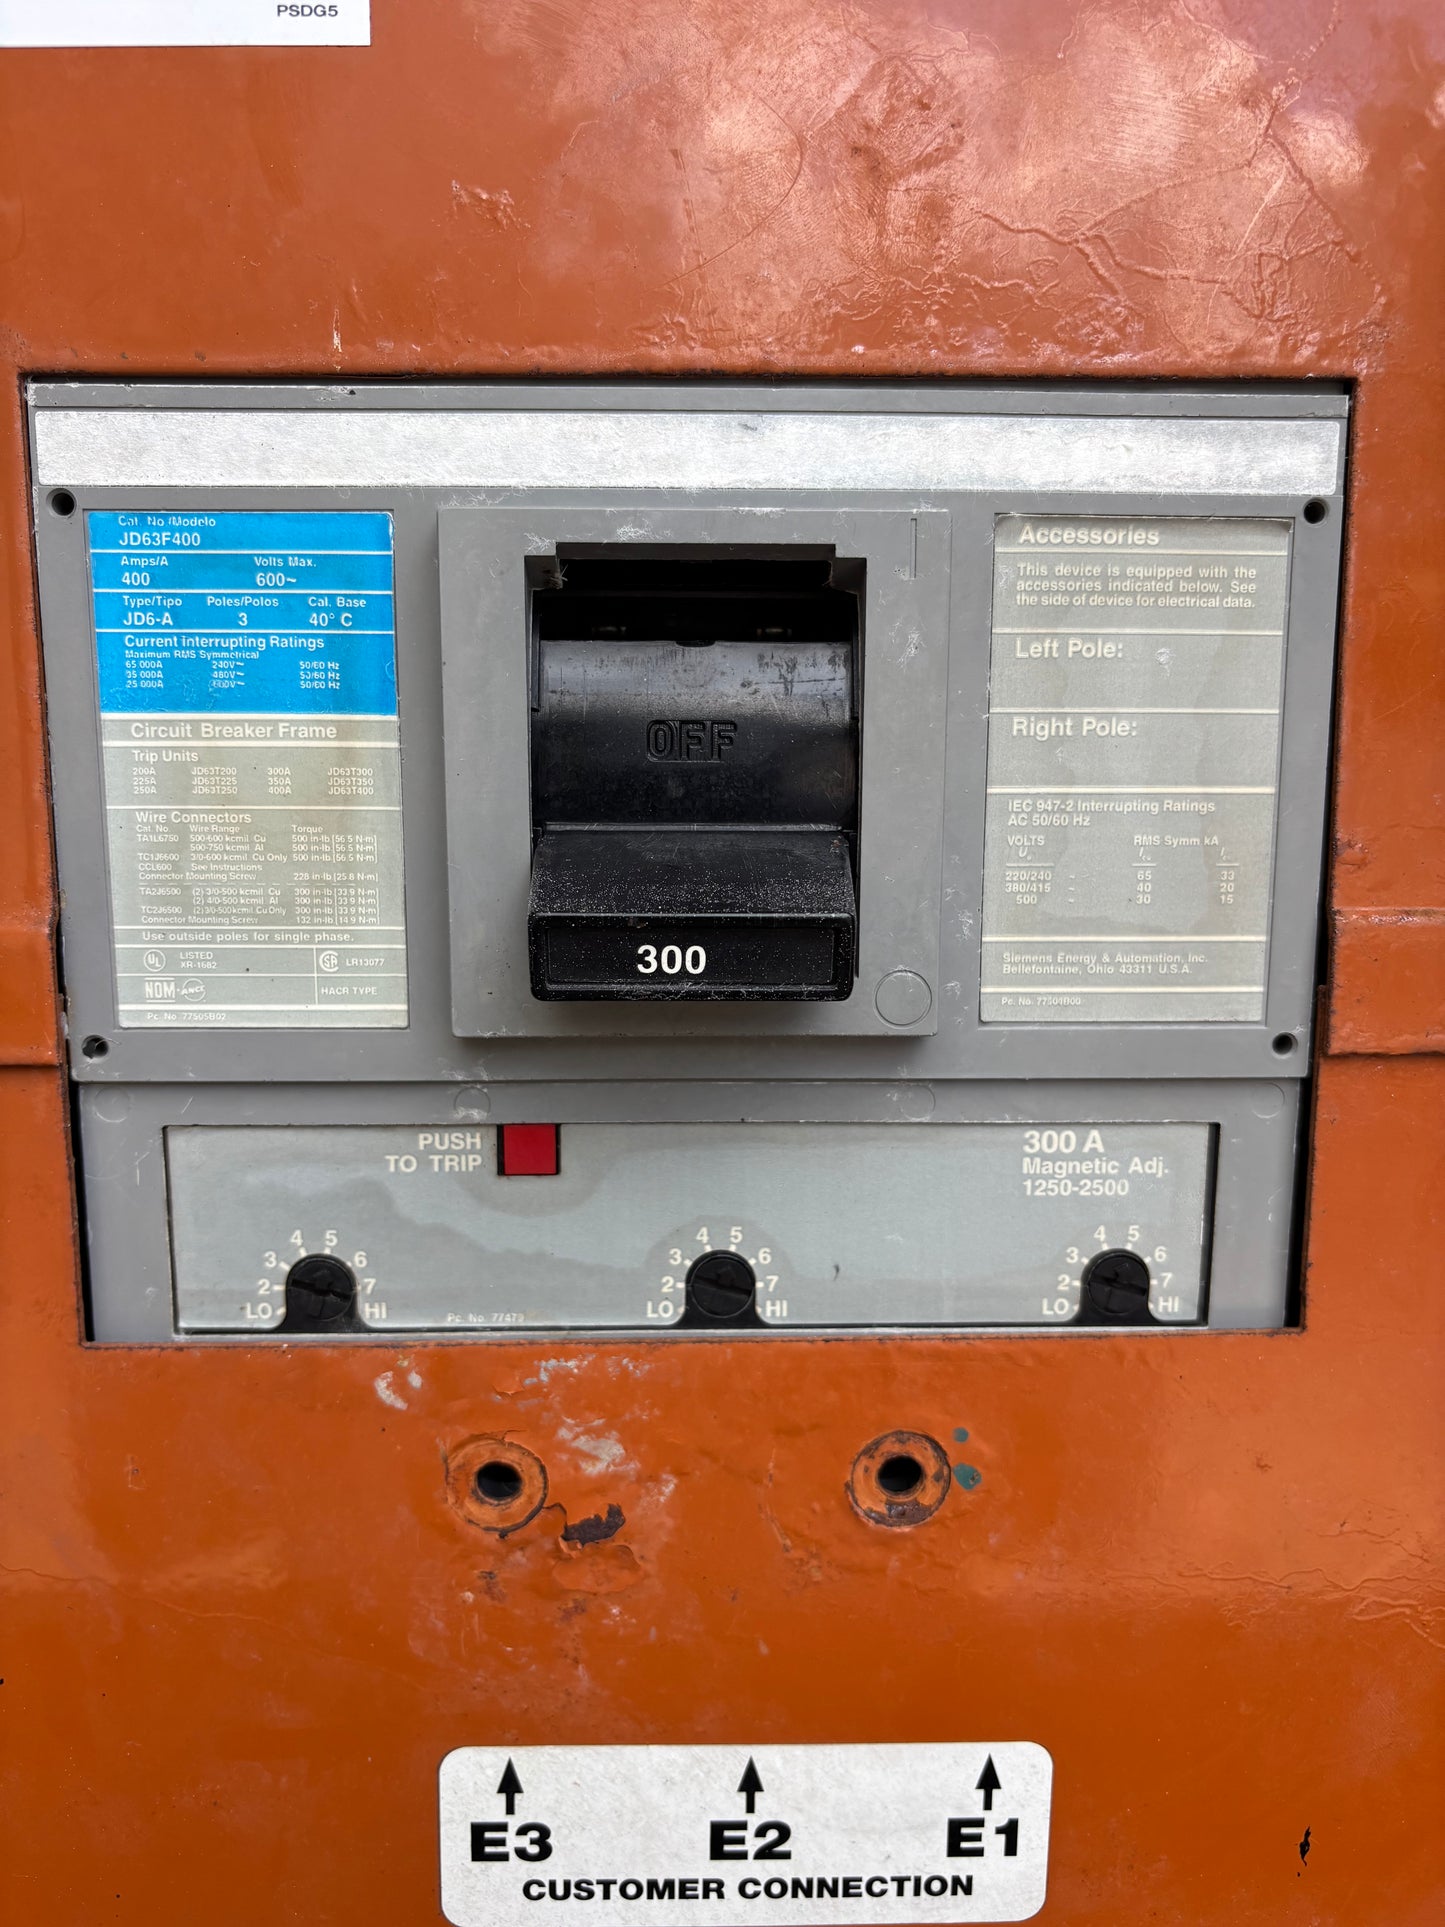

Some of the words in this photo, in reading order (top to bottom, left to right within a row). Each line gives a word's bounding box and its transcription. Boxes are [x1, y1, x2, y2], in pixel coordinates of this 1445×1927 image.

[277, 4, 339, 18] PSDG5
[119, 531, 201, 546] JD63F400
[1018, 522, 1159, 546] Accessories
[121, 555, 169, 568] Amps/A
[254, 556, 284, 567] Volts
[288, 556, 317, 567] Max.
[122, 572, 151, 586] 400
[1017, 563, 1048, 576] This
[1055, 563, 1101, 577] device
[1108, 564, 1120, 577] is
[1126, 565, 1192, 580] equipped
[1199, 565, 1228, 578] with
[1234, 566, 1256, 579] the
[1016, 579, 1101, 592] accessories
[1108, 579, 1173, 592] indicated
[1179, 580, 1223, 593] below.
[1230, 582, 1256, 594] See
[123, 596, 183, 610] Type/Tipo
[206, 596, 279, 608] Poles/Polos
[308, 597, 332, 608] Cal.
[337, 597, 367, 608] Base
[1016, 593, 1037, 606] the
[1041, 593, 1069, 606] side
[1072, 594, 1086, 606] of
[1089, 594, 1133, 607] device
[1136, 594, 1154, 607] for
[1158, 595, 1220, 607] electrical
[1223, 596, 1255, 608] data.
[123, 612, 174, 627] JD6-A
[238, 613, 249, 627] 3
[309, 613, 335, 627] 40°
[340, 613, 353, 627] C
[124, 634, 178, 647] Current
[181, 635, 266, 651] Interrupting
[269, 635, 325, 652] Ratings
[1015, 637, 1059, 658] Left
[1067, 638, 1122, 658] Pole:
[125, 650, 171, 658] Maximum
[174, 650, 197, 659] RMS
[199, 650, 259, 660] Symmetrical
[131, 723, 192, 739] Circuit
[201, 723, 273, 739] Breaker
[278, 723, 337, 739] Frame
[1012, 716, 1072, 741] Right
[1082, 717, 1137, 737] Pole:
[646, 719, 738, 763] OFF
[132, 750, 160, 764] Trip
[162, 750, 199, 762] Units
[132, 767, 156, 776] 200A
[191, 767, 237, 776] JD63T200
[267, 767, 291, 776] 300A
[327, 767, 373, 776] JD63T300
[133, 777, 157, 785] 225A
[192, 777, 238, 786] JD63T225
[267, 777, 291, 786] 350A
[134, 786, 157, 795] 250A
[192, 786, 238, 795] JD63T250
[268, 787, 292, 795] 400A
[328, 786, 374, 795] JD63T400
[1008, 799, 1033, 812] IEC
[1036, 800, 1073, 812] 947-2
[1077, 799, 1159, 815] Interrupting
[1163, 799, 1216, 815] Ratings
[136, 811, 167, 823] Wire
[171, 811, 252, 823] Connectors
[1007, 814, 1028, 826] AC
[1032, 814, 1068, 826] 50/60
[1073, 814, 1091, 826] Hz
[189, 825, 210, 833] Wire
[211, 825, 240, 834] Range
[291, 825, 323, 835] Torque
[1007, 834, 1045, 846] VOLTS
[1134, 835, 1160, 846] RMS
[1203, 835, 1219, 846] kA
[210, 863, 263, 871] Instructions
[139, 872, 184, 880] Connector
[186, 872, 228, 882] Mounting
[230, 872, 257, 880] Screw
[1005, 871, 1052, 881] 220/240
[1137, 871, 1152, 881] 65
[1220, 871, 1235, 881] 33
[1004, 882, 1051, 893] 380/415
[1136, 882, 1152, 892] 40
[1220, 882, 1235, 892] 20
[1016, 894, 1037, 904] 500
[1136, 894, 1151, 904] 30
[1220, 895, 1234, 904] 15
[142, 931, 165, 942] Use
[169, 931, 212, 942] outside
[217, 932, 249, 944] poles
[253, 931, 271, 942] for
[274, 932, 312, 945] single
[315, 932, 354, 944] phase.
[180, 951, 213, 960] LISTED
[346, 958, 385, 966] LR13077
[636, 945, 707, 975] 300
[1003, 952, 1053, 963] Siemens
[1057, 952, 1097, 966] Energy
[1102, 953, 1110, 963] &
[1188, 953, 1208, 963] Inc.
[1003, 963, 1082, 975] Bellefontaine,
[1087, 963, 1115, 974] Ohio
[1119, 964, 1152, 974] 43311
[1158, 964, 1193, 975] U.S.A.
[321, 986, 349, 995] HACR
[352, 986, 378, 995] TYPE
[418, 1132, 482, 1150] PUSH
[1023, 1131, 1077, 1154] 300
[1082, 1130, 1105, 1153] A
[385, 1155, 418, 1173] TO
[429, 1155, 483, 1173] TRIP
[1022, 1157, 1119, 1178] Magnetic
[1128, 1157, 1170, 1178] Adj.
[1022, 1179, 1130, 1197] 1250-2500
[290, 1231, 302, 1247] 4
[325, 1231, 338, 1247] 5
[696, 1227, 709, 1243] 4
[730, 1227, 743, 1243] 5
[1093, 1226, 1106, 1242] 4
[1127, 1225, 1140, 1242] 5
[264, 1253, 277, 1268] 3
[354, 1253, 367, 1268] 6
[669, 1249, 682, 1265] 3
[758, 1248, 771, 1265] 6
[1066, 1248, 1079, 1264] 3
[1154, 1246, 1167, 1262] 6
[258, 1279, 271, 1295] 2
[365, 1279, 376, 1294] 7
[661, 1276, 674, 1293] 2
[766, 1276, 779, 1292] 7
[1057, 1275, 1070, 1292] 2
[1160, 1273, 1173, 1289] 7
[246, 1303, 273, 1320] LO
[365, 1303, 388, 1319] HI
[646, 1300, 673, 1318] LO
[766, 1300, 788, 1317] HI
[1042, 1298, 1069, 1316] LO
[1158, 1296, 1180, 1313] HI
[470, 1820, 553, 1863] E3
[709, 1818, 793, 1862] E2
[946, 1816, 1020, 1859] E1
[522, 1877, 726, 1902] CUSTOMER
[738, 1874, 974, 1899] CONNECTION
